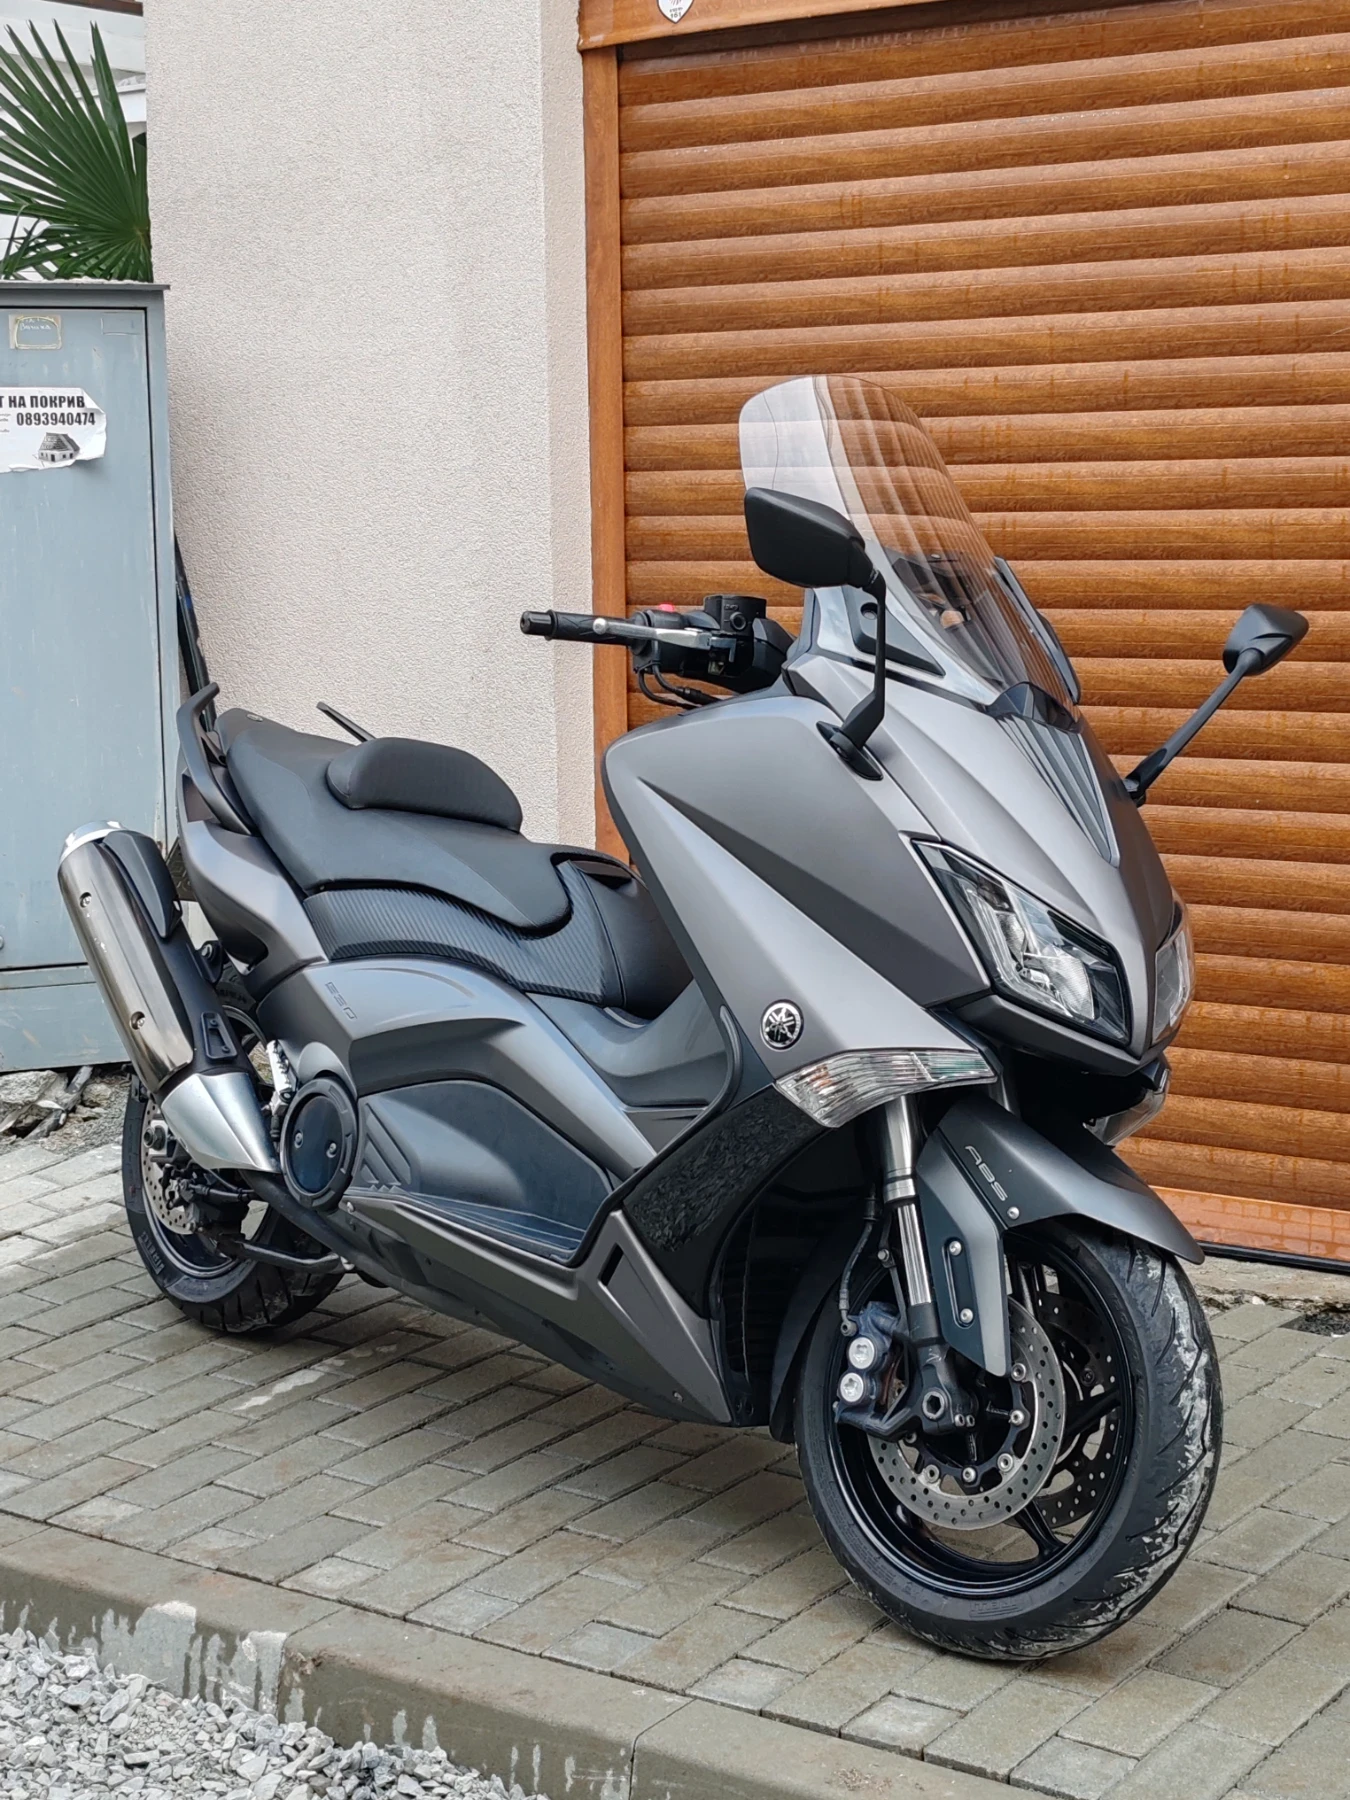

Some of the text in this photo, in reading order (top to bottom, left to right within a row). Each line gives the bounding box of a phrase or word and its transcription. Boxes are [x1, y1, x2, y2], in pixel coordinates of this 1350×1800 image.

[8, 395, 27, 409] НА
[30, 395, 86, 409] ПОКРИВ
[16, 412, 96, 426] 0893940474
[965, 1145, 1009, 1202] ABS
[137, 1230, 165, 1275] PIRELLI
